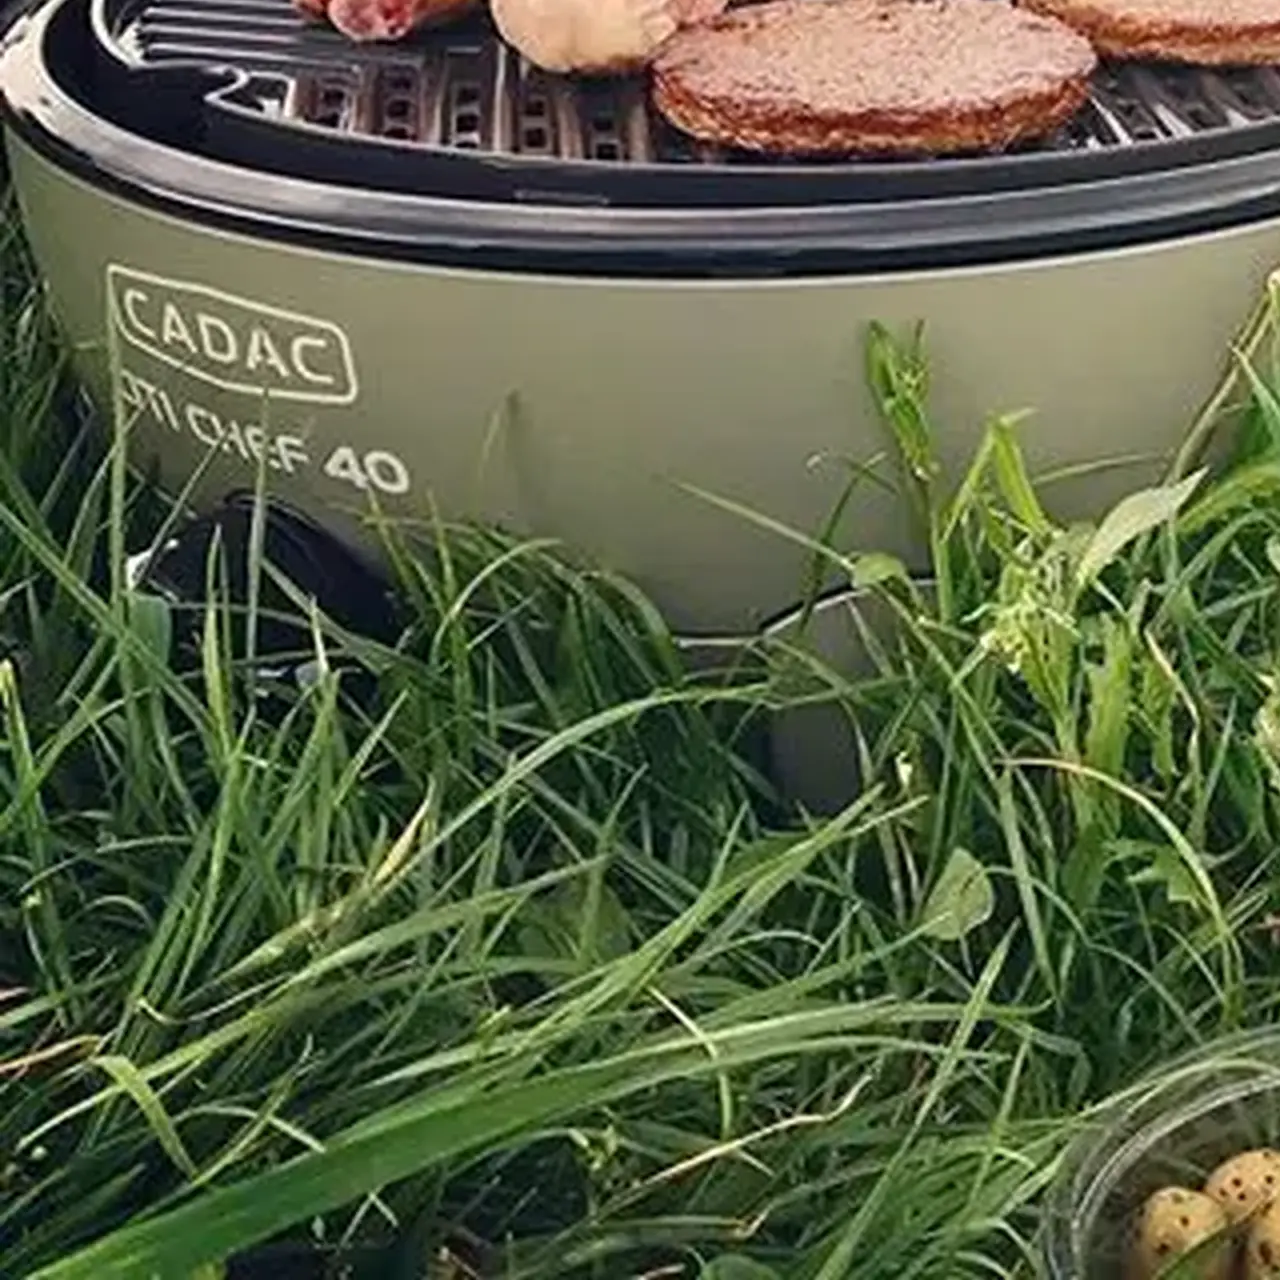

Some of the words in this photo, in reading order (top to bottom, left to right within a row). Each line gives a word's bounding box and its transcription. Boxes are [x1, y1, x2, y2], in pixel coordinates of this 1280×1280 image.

[122, 288, 334, 384] CADAC
[184, 403, 312, 473] CHEF
[323, 445, 411, 494] 40
